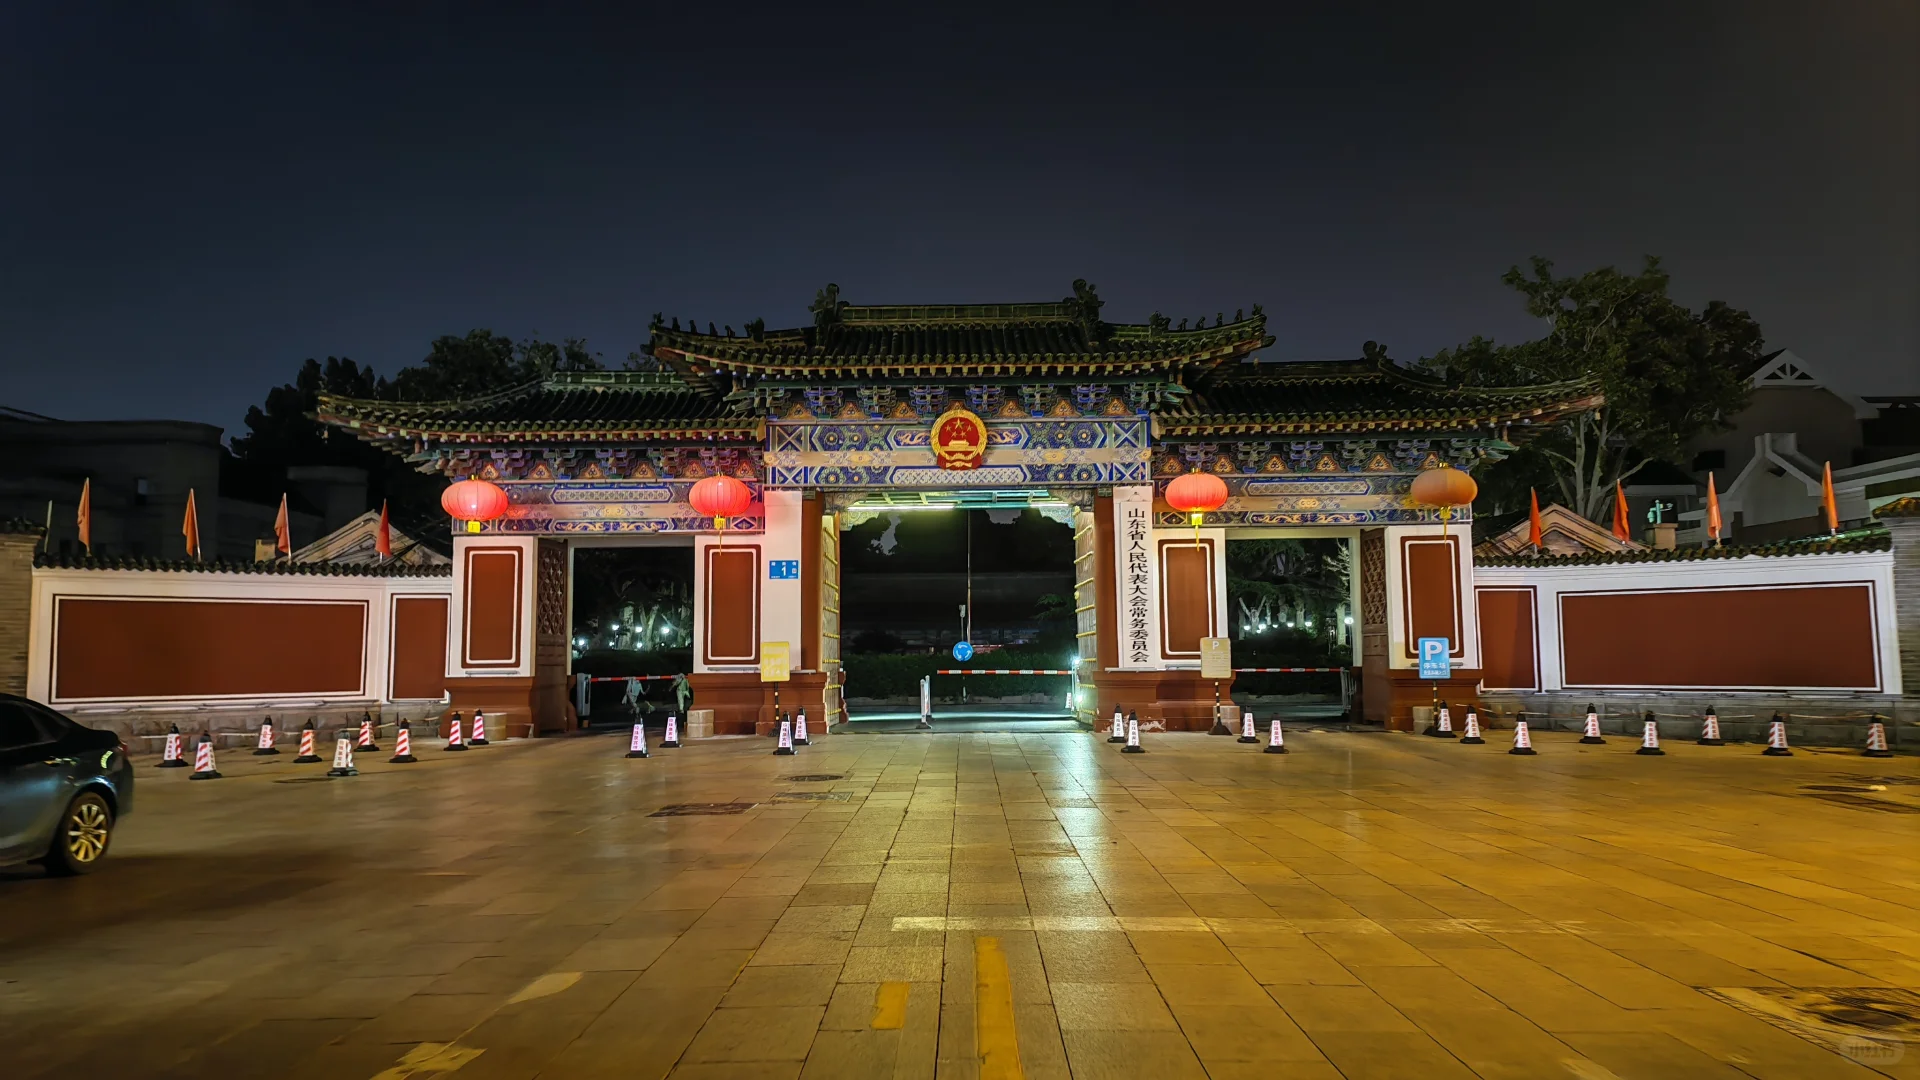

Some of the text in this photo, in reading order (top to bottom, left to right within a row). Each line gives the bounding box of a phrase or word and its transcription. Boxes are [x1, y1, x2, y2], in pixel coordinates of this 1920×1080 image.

[781, 566, 787, 576] 1
[1128, 508, 1150, 663] 山东省人民代表大会常务委员会
[1212, 640, 1220, 651] P
[1424, 641, 1443, 661] P
